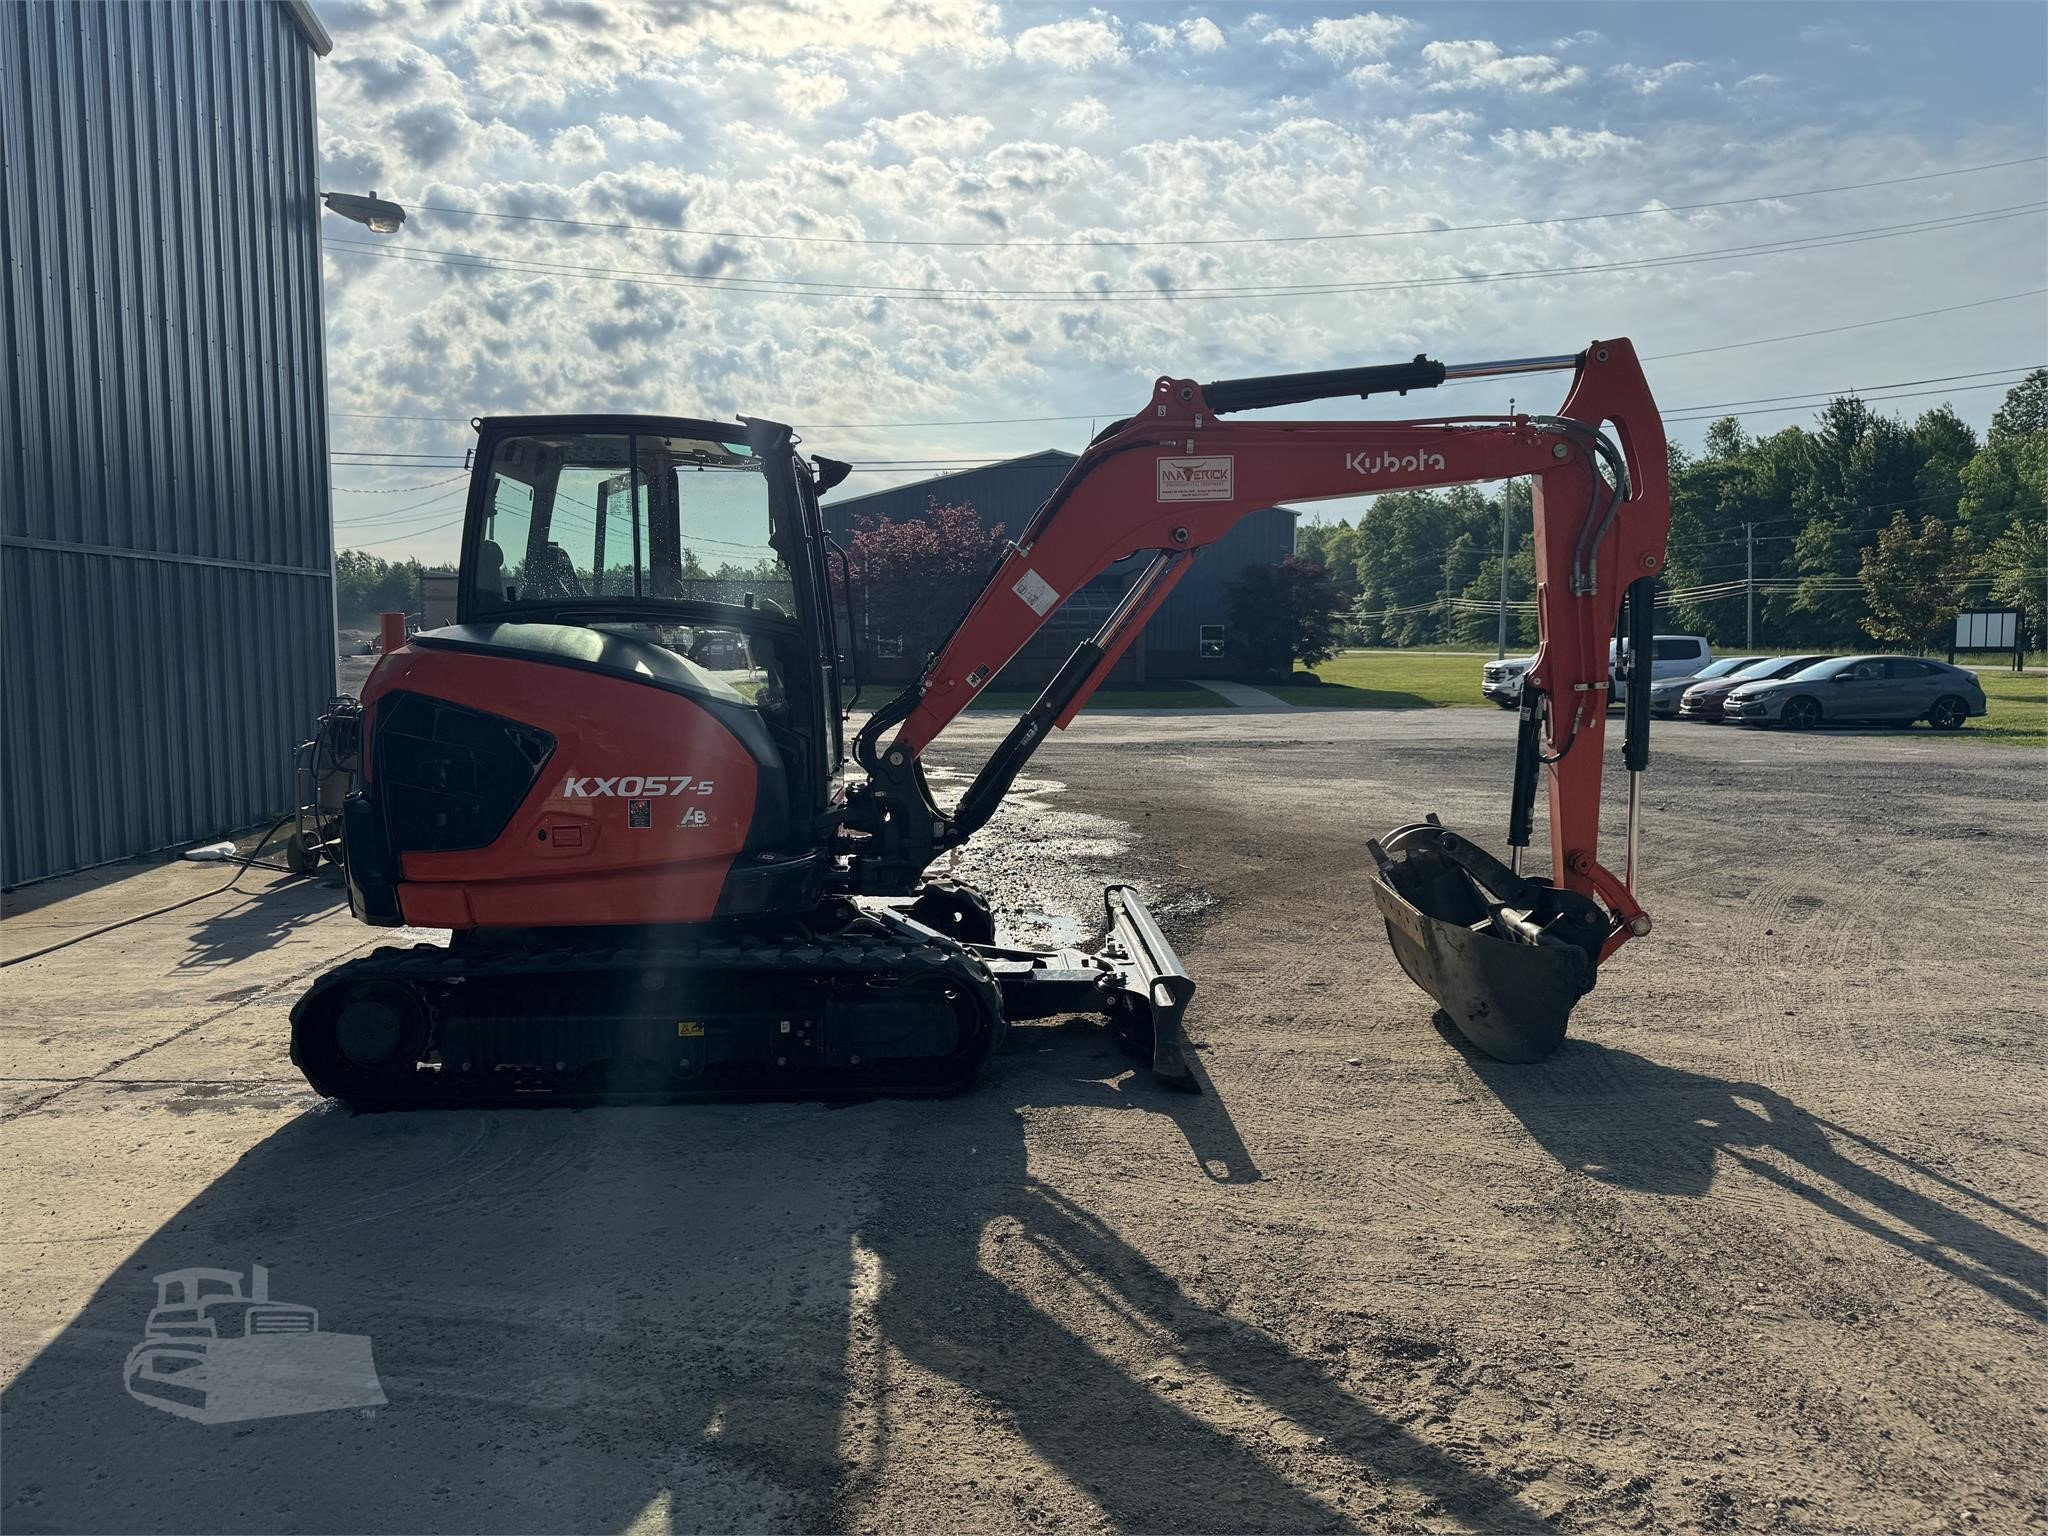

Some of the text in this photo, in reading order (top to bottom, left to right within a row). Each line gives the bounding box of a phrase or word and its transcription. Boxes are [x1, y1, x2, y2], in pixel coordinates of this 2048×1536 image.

[1345, 448, 1445, 474] Kubota
[1162, 468, 1229, 482] MAVERICK
[563, 776, 714, 798] KX057-5
